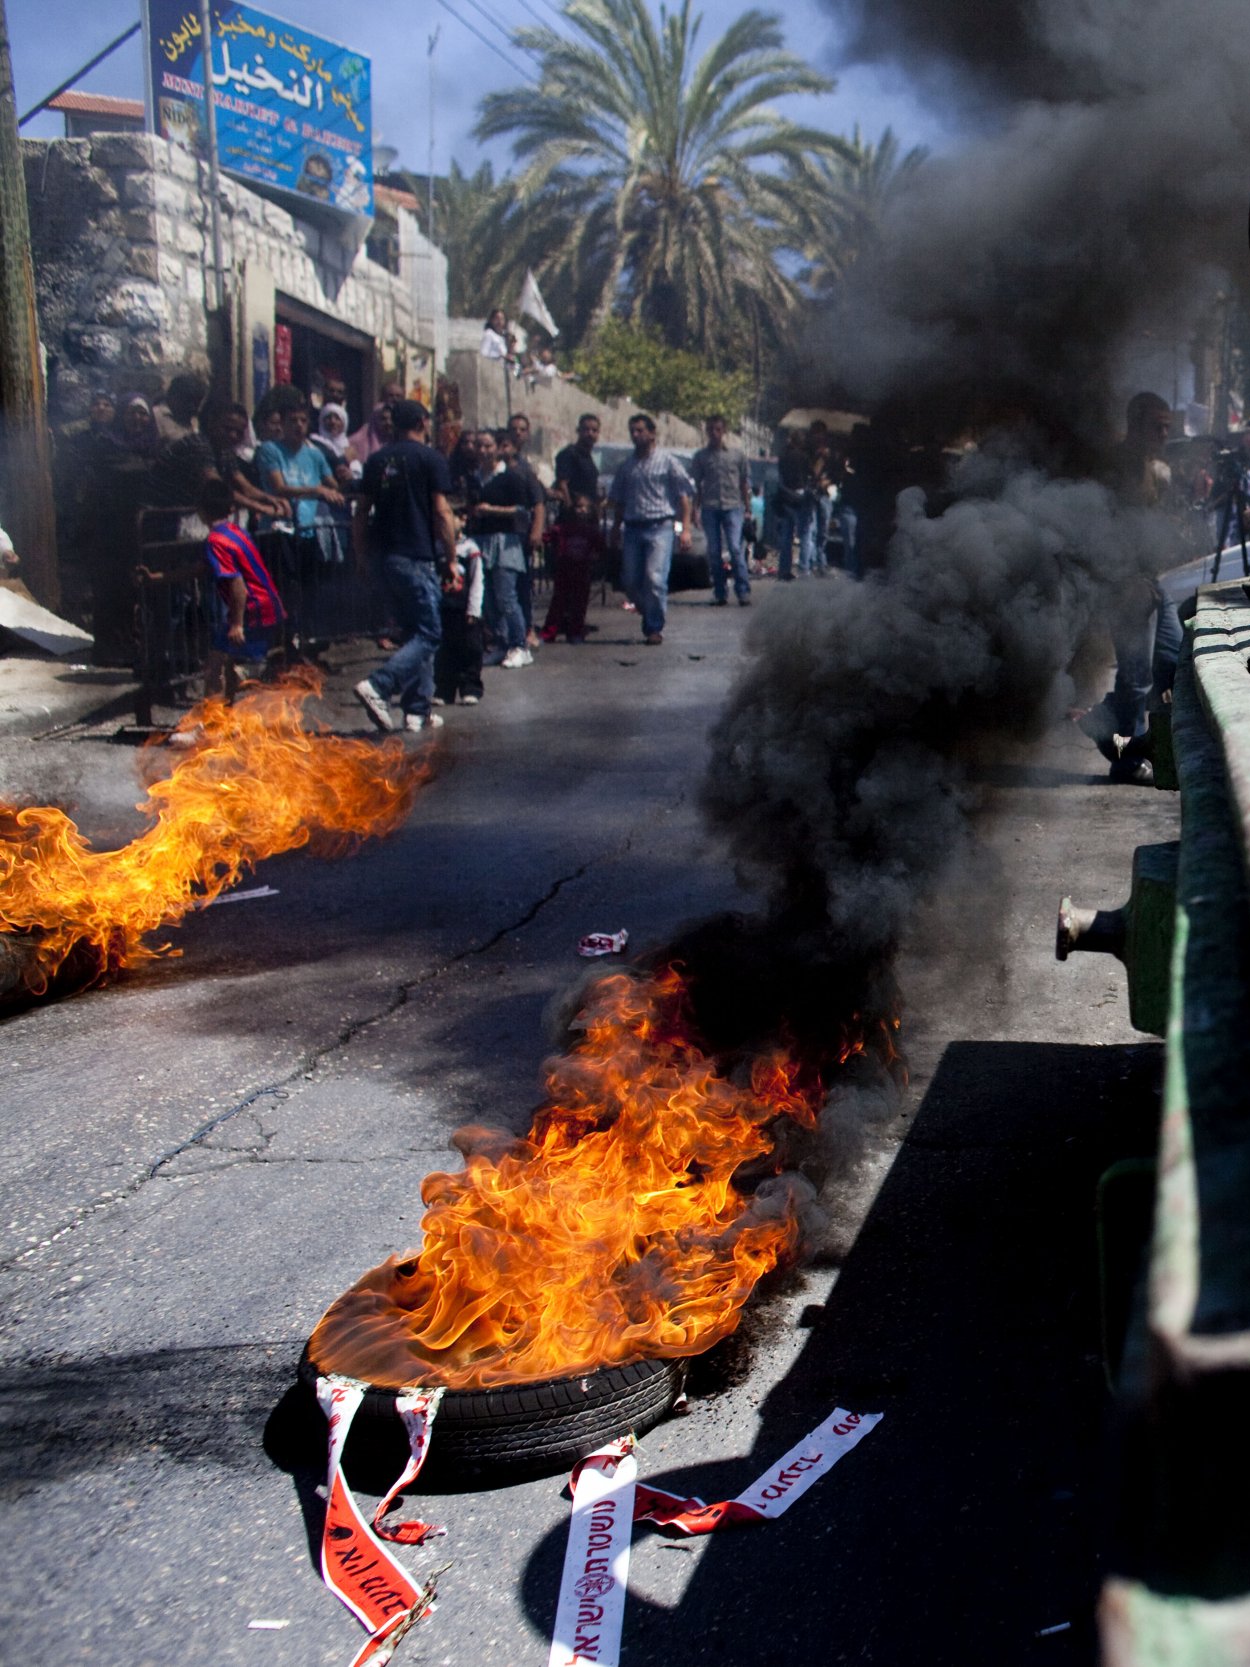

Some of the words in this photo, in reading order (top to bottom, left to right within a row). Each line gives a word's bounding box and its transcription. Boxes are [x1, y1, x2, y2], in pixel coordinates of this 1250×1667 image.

[159, 12, 202, 62] طابون
[214, 10, 276, 49] ومخبز
[211, 40, 324, 113] النخيل
[279, 33, 332, 83] ماركت
[210, 89, 280, 127] MARKET
[282, 117, 299, 134] &
[302, 122, 363, 156] BAKERY
[335, 1546, 379, 1578] אין
[584, 1499, 617, 1575] משטרת
